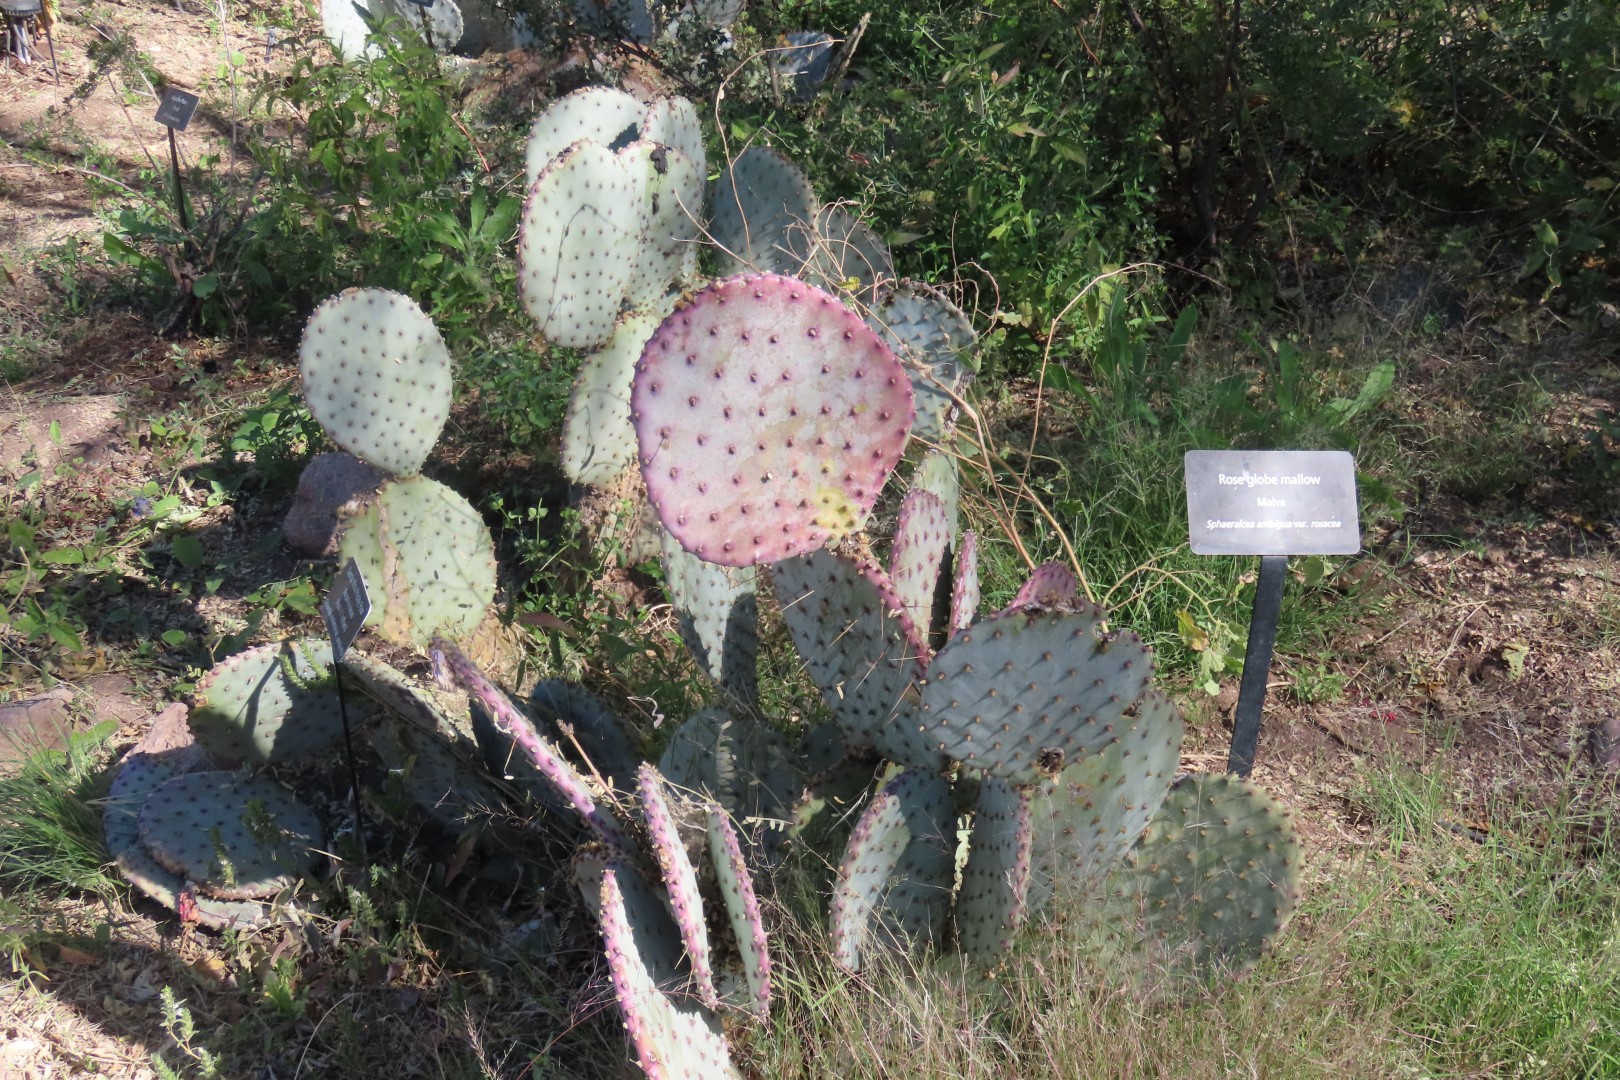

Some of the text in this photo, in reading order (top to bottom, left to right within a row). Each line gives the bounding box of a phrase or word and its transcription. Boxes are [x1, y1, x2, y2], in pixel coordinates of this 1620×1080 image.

[1218, 473, 1321, 488] Rose globe mallow
[1256, 496, 1286, 507] Malva
[1206, 519, 1341, 531] Sphaeralcea ambigua var. rosacea
